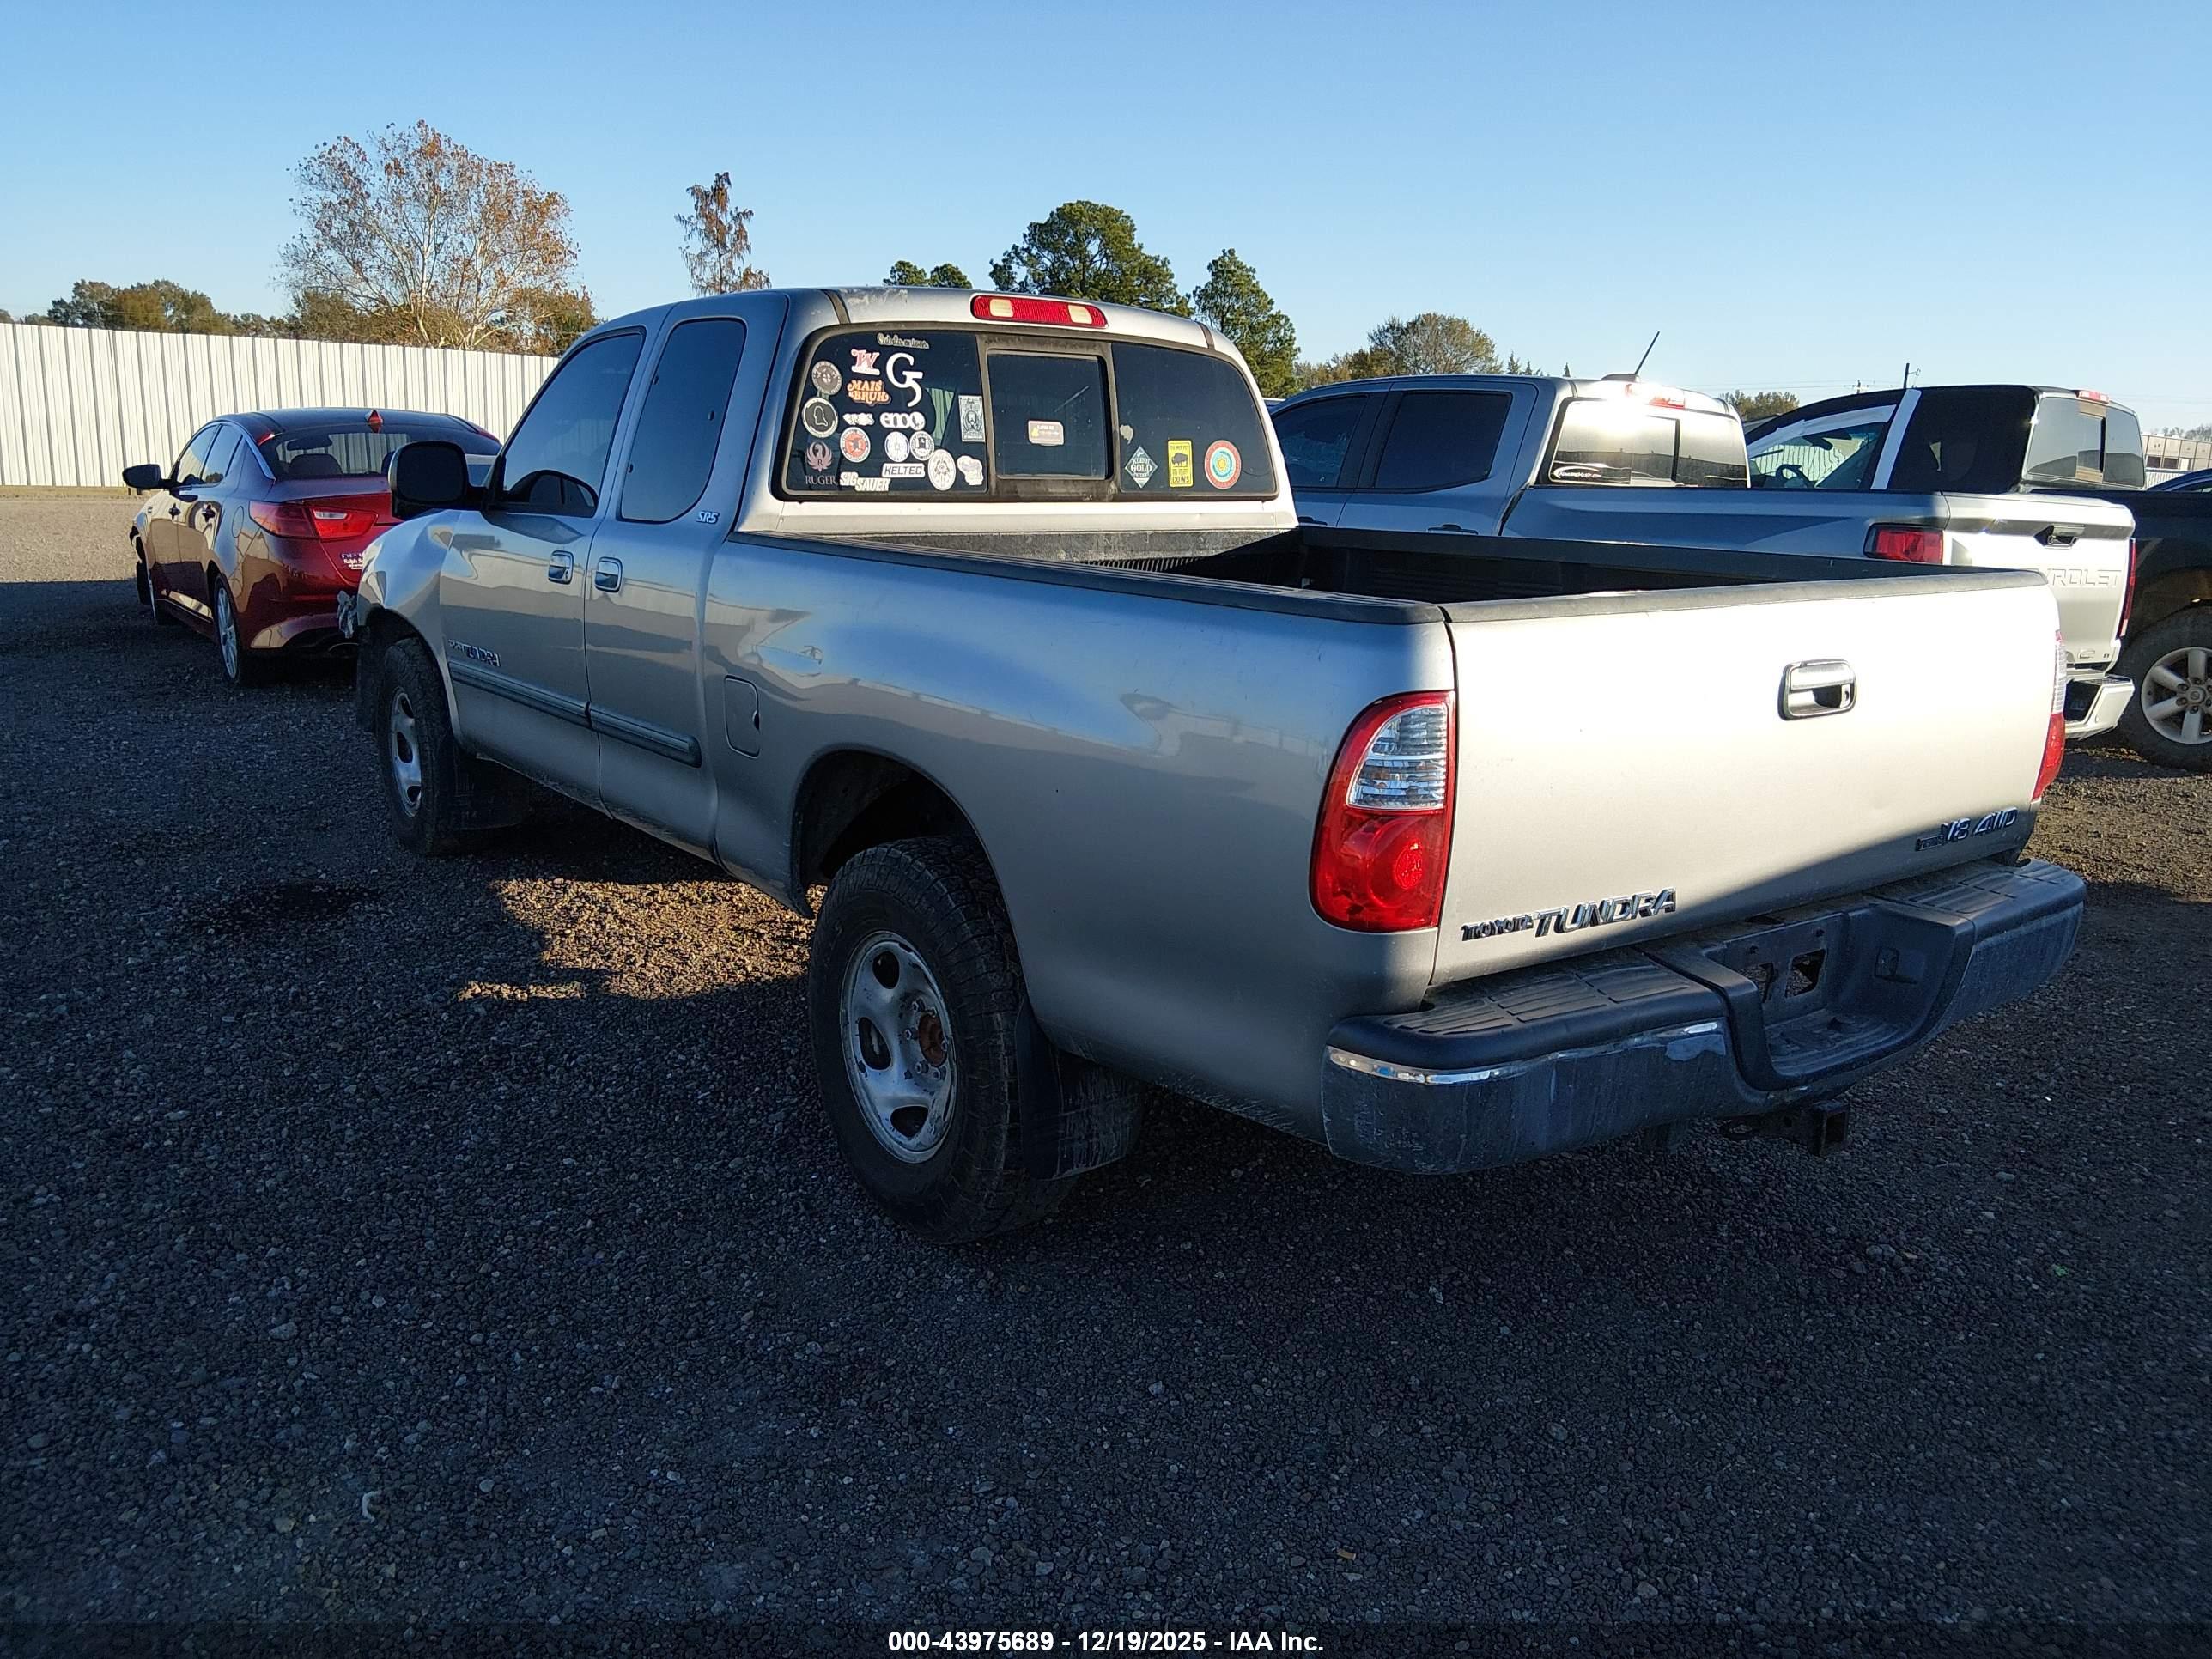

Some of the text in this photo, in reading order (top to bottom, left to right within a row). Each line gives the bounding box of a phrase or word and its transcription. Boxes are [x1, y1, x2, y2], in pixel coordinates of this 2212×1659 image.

[847, 380, 883, 392] MAIS
[848, 391, 890, 404] BRUH
[884, 465, 923, 476] KELTEC
[1131, 464, 1152, 472] GOLD
[805, 476, 838, 485] RUGER
[840, 472, 890, 491] SIG SAUER
[696, 511, 720, 523] SR5
[1941, 817, 1971, 842] V8
[1461, 887, 1677, 942] TOYOTA TUNDRA
